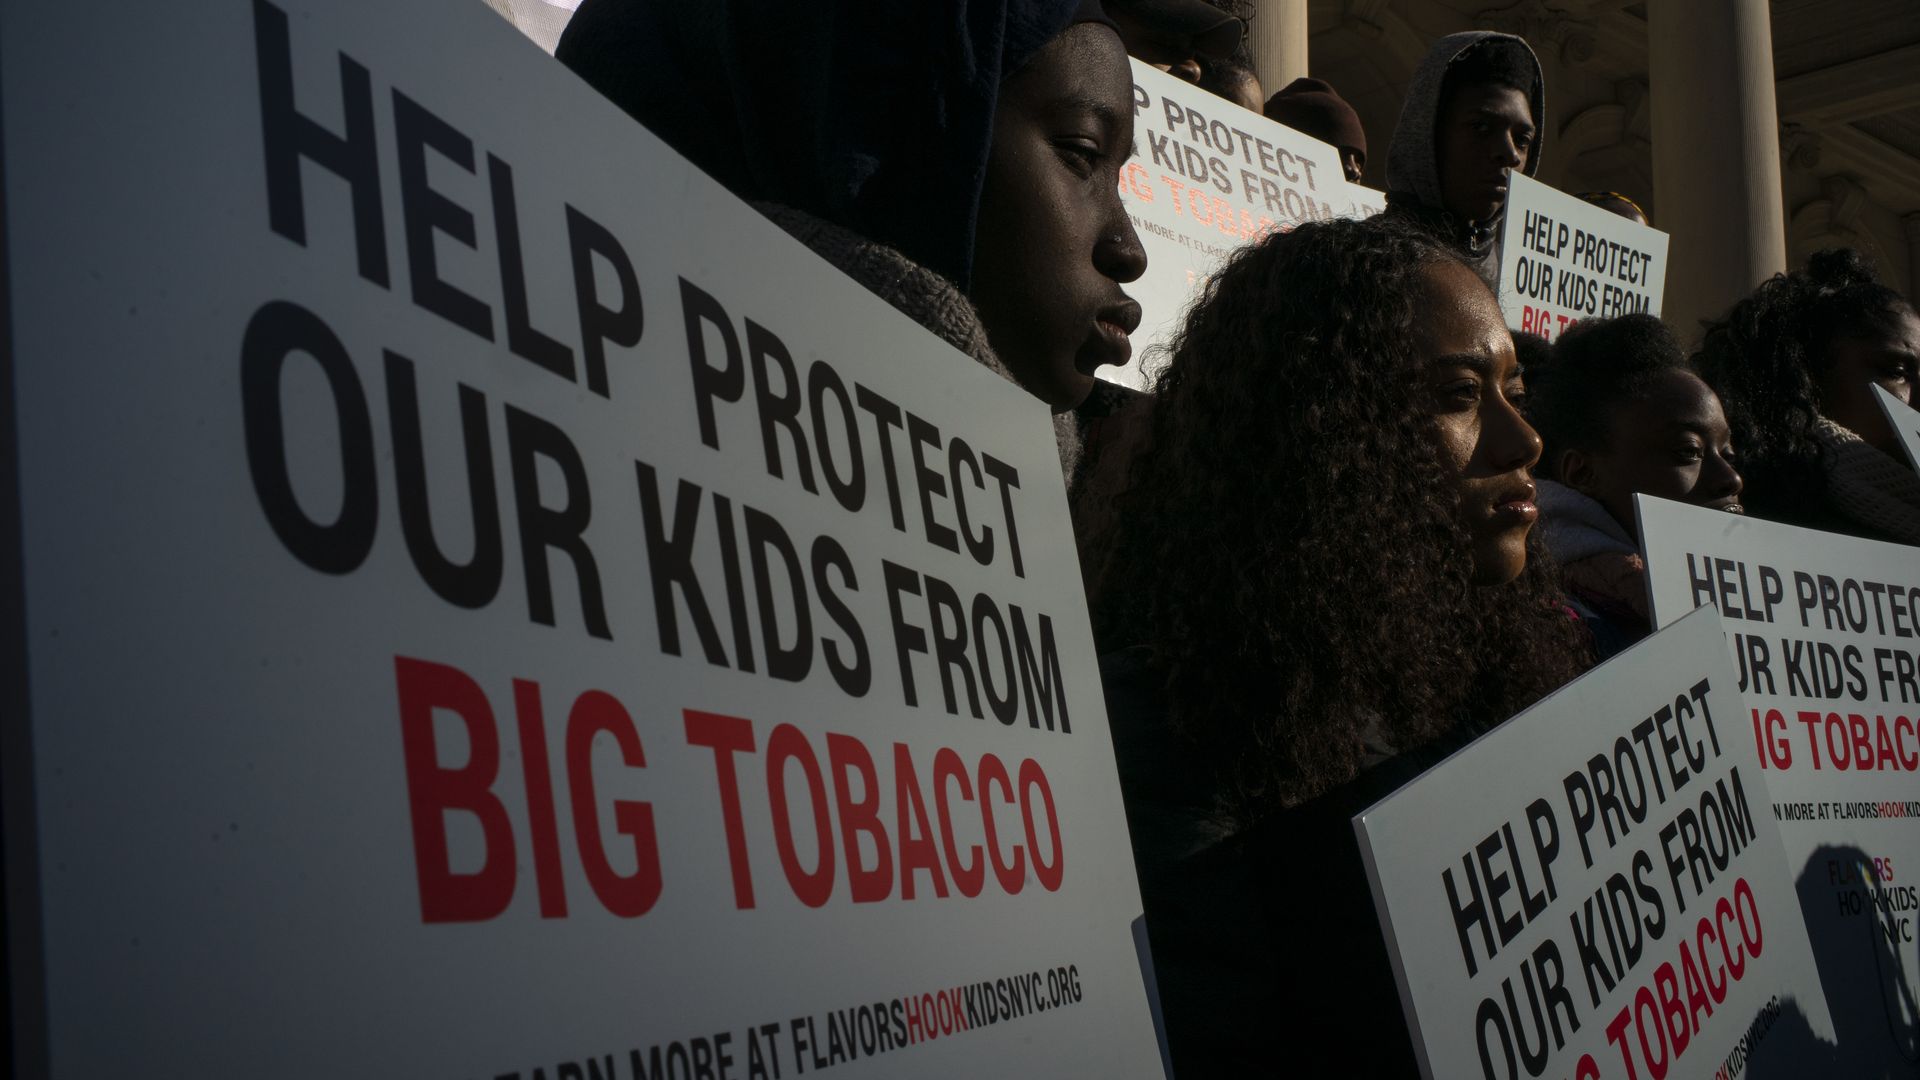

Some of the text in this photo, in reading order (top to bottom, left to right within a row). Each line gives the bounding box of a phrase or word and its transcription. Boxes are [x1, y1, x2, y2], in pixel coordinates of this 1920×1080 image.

[1147, 128, 1233, 194] KIDS
[1161, 96, 1316, 191] PROTECT
[1119, 162, 1154, 203] IG
[1144, 219, 1175, 241] MORE
[1178, 233, 1191, 248] AT
[1522, 209, 1652, 287] HELP PROTECT
[253, 0, 1024, 579] HELP PROTECT
[1515, 256, 1650, 319] OUR KIDS FROM
[1522, 305, 1551, 340] BIG
[241, 299, 1071, 734] OUR KIDS FROM
[1686, 552, 1783, 623] HELP
[1781, 638, 1868, 701] KIDS
[1873, 647, 1920, 704] FR
[1751, 708, 1920, 771] IG TOBAC
[394, 654, 1063, 924] BIG TOBACCO
[1783, 803, 1815, 820] MORE
[1818, 802, 1829, 819] AT
[1441, 677, 1721, 979] HELP PROTECT
[1476, 766, 1757, 1080] OUR KIDS FROM
[1881, 917, 1912, 945] NYC
[1605, 877, 1763, 1080] TOBACCO
[747, 1022, 781, 1080] AT
[791, 964, 1083, 1074] FLAVORSHOOKKIDSNYC.ORG
